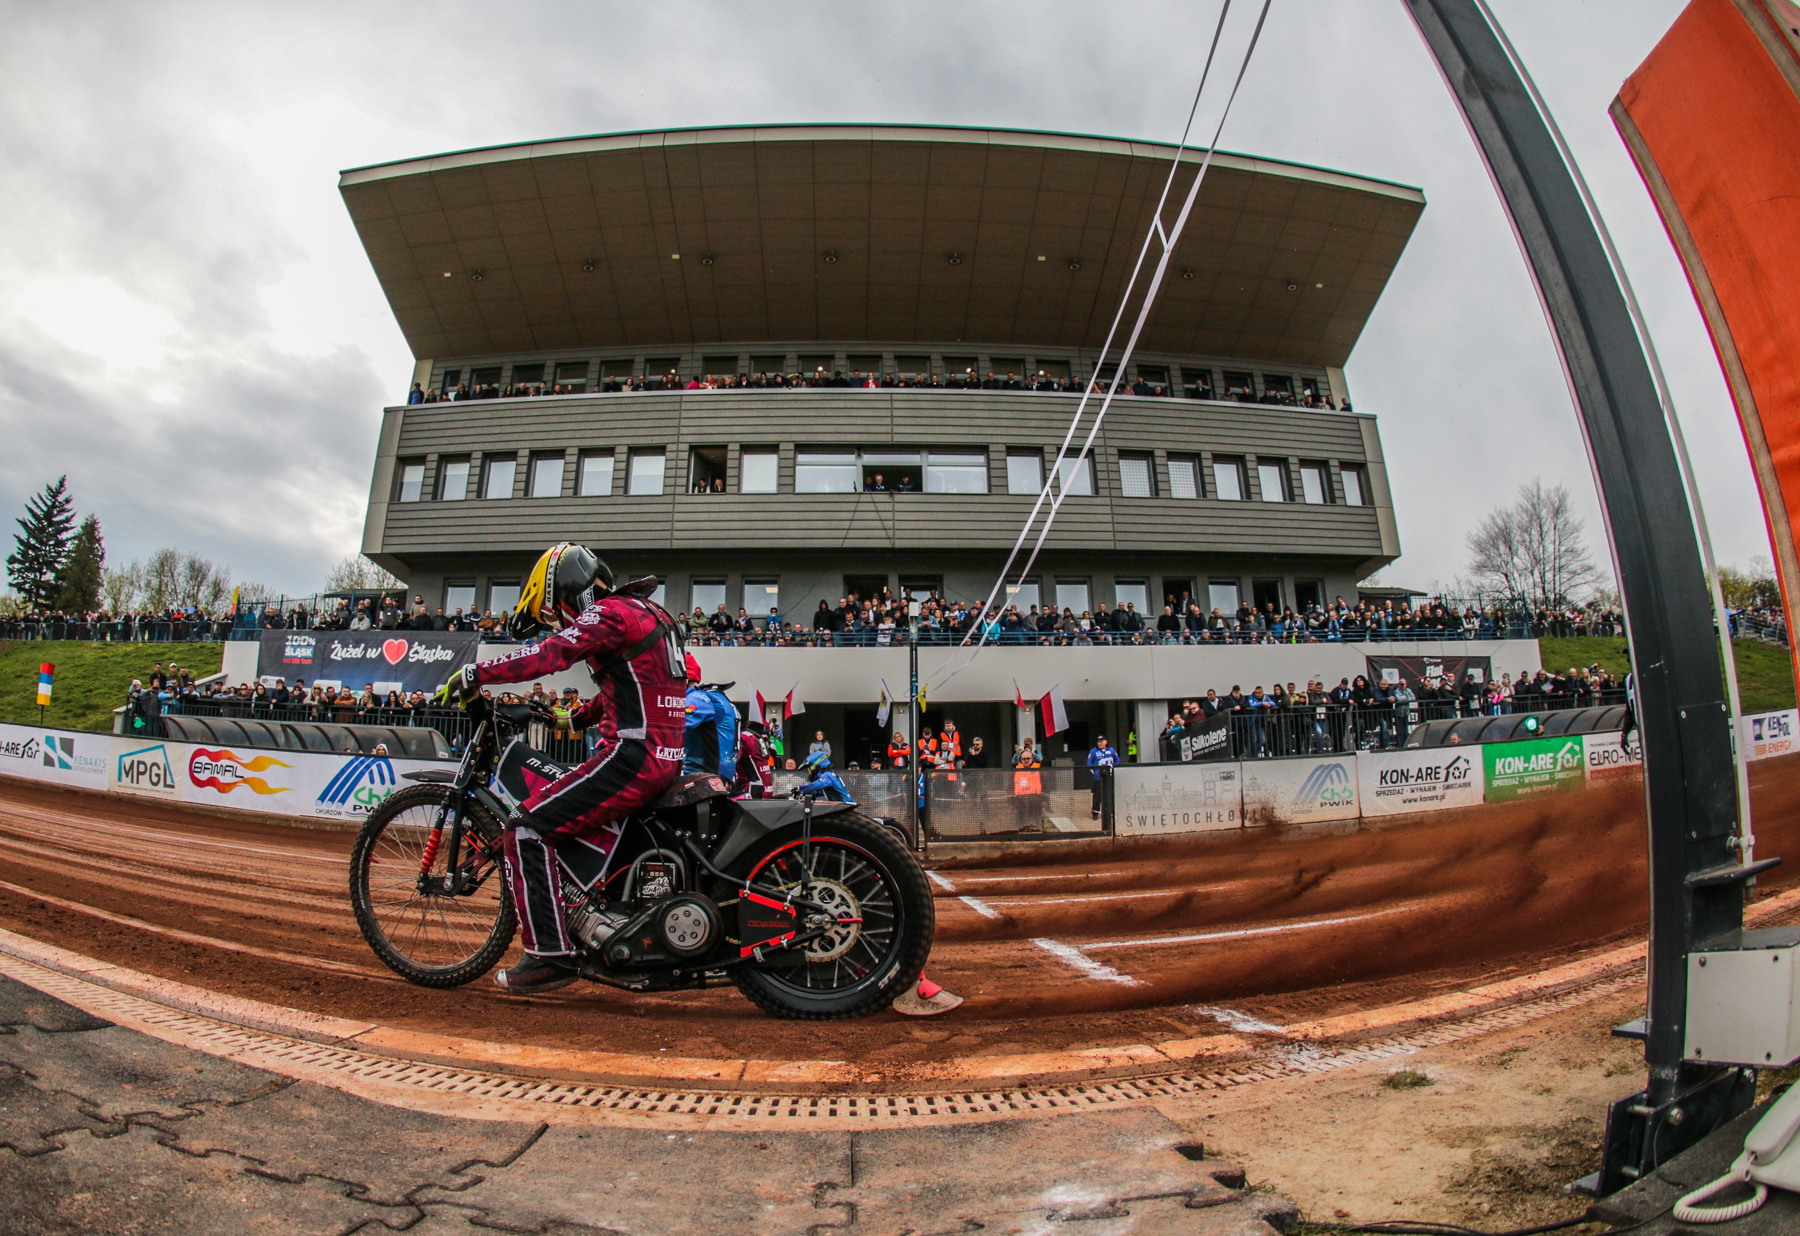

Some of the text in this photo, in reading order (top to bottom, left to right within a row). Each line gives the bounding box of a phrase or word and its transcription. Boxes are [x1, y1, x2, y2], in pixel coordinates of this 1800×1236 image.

[545, 564, 554, 603] OAKLEY
[285, 635, 316, 646] 100%
[284, 646, 312, 658] ŚLĄSK
[330, 640, 455, 663] Żużel w Śląska
[482, 644, 541, 668] FIXERS
[0, 741, 21, 755] -ARE
[1191, 728, 1227, 752] Silkolene
[74, 756, 107, 768] KENAKIS
[193, 762, 245, 779] BAMAL
[1495, 752, 1554, 775] KON-ARE
[123, 759, 175, 789] MPGL
[1379, 766, 1442, 785] KON-ARE
[1375, 788, 1404, 797] SPRZEDAŻ
[1410, 785, 1437, 794] WYNAJEM
[1402, 793, 1446, 804] www.konare.pl
[315, 808, 342, 816] CHORZÓW
